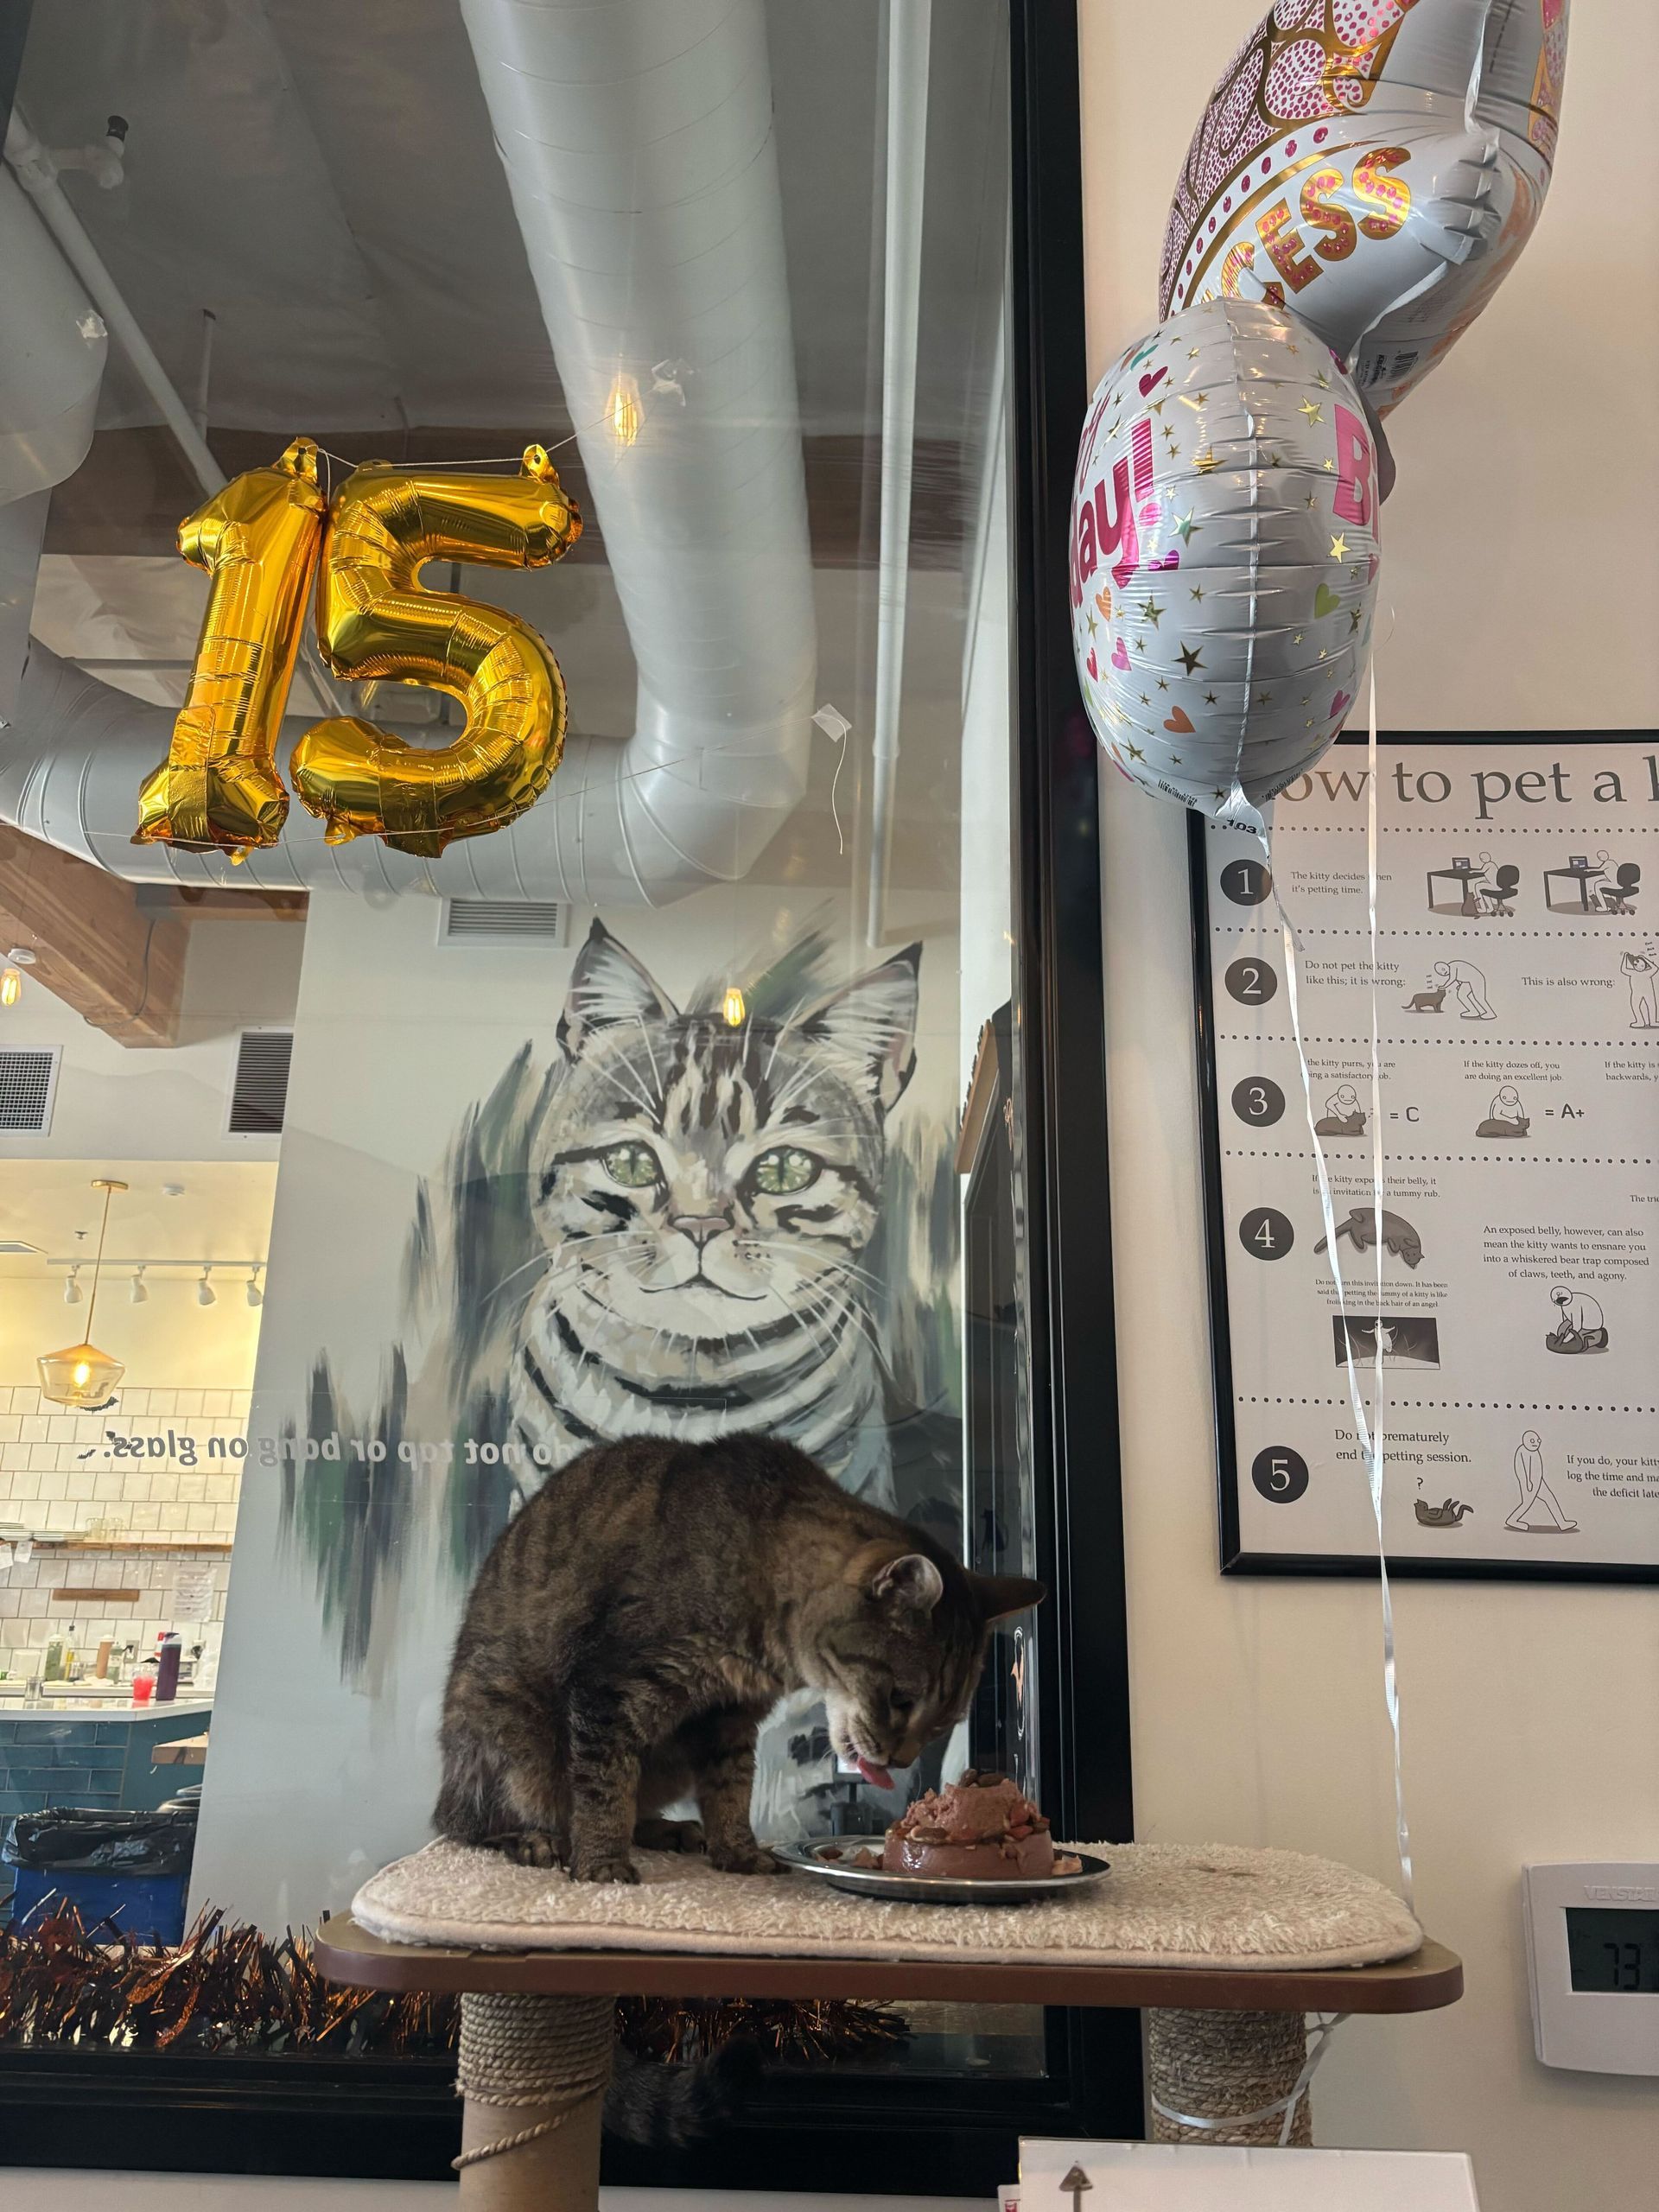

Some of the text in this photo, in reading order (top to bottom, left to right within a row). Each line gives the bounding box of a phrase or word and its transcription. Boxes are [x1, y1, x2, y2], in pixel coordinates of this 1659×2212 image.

[1202, 147, 1411, 310] CESS
[130, 437, 582, 865] 15
[1274, 771, 1370, 802] ow
[1391, 762, 1452, 803] to
[1471, 762, 1573, 820] pet
[1593, 771, 1627, 803] a
[1237, 868, 1254, 894] 1
[1290, 871, 1307, 880] The
[1309, 871, 1331, 882] kitty
[1332, 872, 1365, 881] decides
[1292, 885, 1363, 895] it's petting time.
[1305, 960, 1319, 969] Do
[1341, 962, 1356, 971] pet
[1358, 962, 1374, 970] the
[1376, 962, 1400, 973] kitty
[1242, 967, 1262, 995] 2
[1306, 976, 1406, 988] like this; it is wrong:
[1522, 977, 1616, 988] This is also wrong:
[1321, 1058, 1339, 1069] kitty
[1485, 1061, 1503, 1070] kitty
[1627, 1061, 1646, 1071] kitty
[1331, 1071, 1374, 1081] satisfactory
[1378, 1072, 1391, 1081] ob.
[1478, 1073, 1501, 1082] doing
[1605, 1073, 1651, 1082] backwards,
[1249, 1086, 1268, 1116] 3
[1405, 1106, 1420, 1122] C
[1560, 1103, 1585, 1119] A+
[1334, 1175, 1353, 1185] kitty
[1387, 1176, 1406, 1185] their
[1408, 1177, 1428, 1186] belly,
[1393, 1190, 1422, 1198] tummy
[1630, 1194, 1645, 1203] The
[1254, 1218, 1275, 1249] 4
[1483, 1225, 1497, 1234] An
[1498, 1226, 1535, 1236] exposed
[1537, 1226, 1561, 1237] belly,
[1564, 1226, 1605, 1237] however,
[1624, 1228, 1644, 1236] also
[1510, 1240, 1524, 1249] the
[1527, 1240, 1548, 1251] kitty
[1550, 1242, 1578, 1250] wants
[1629, 1243, 1646, 1254] you
[1483, 1254, 1501, 1262] into
[1511, 1255, 1557, 1264] whiskered
[1560, 1255, 1580, 1264] bear
[1582, 1256, 1601, 1268] trap
[1604, 1257, 1649, 1268] composed
[1508, 1269, 1627, 1282] of claws, teeth, and agony.
[1335, 1429, 1352, 1440] Do
[1336, 1449, 1357, 1460] end
[1382, 1451, 1424, 1465] petting
[1427, 1452, 1471, 1463] session.
[1567, 1454, 1574, 1464] If
[1577, 1457, 1595, 1466] you
[1598, 1456, 1612, 1465] do,
[1616, 1459, 1637, 1467] your
[1269, 1459, 1291, 1491] 5
[1567, 1470, 1582, 1482] log
[1585, 1471, 1600, 1480] the
[1602, 1471, 1624, 1481] time
[1626, 1472, 1643, 1482] and
[1416, 1477, 1424, 1490] ?
[1592, 1486, 1607, 1497] the
[1610, 1488, 1640, 1498] deficit
[1602, 1942, 1642, 1991] 73
